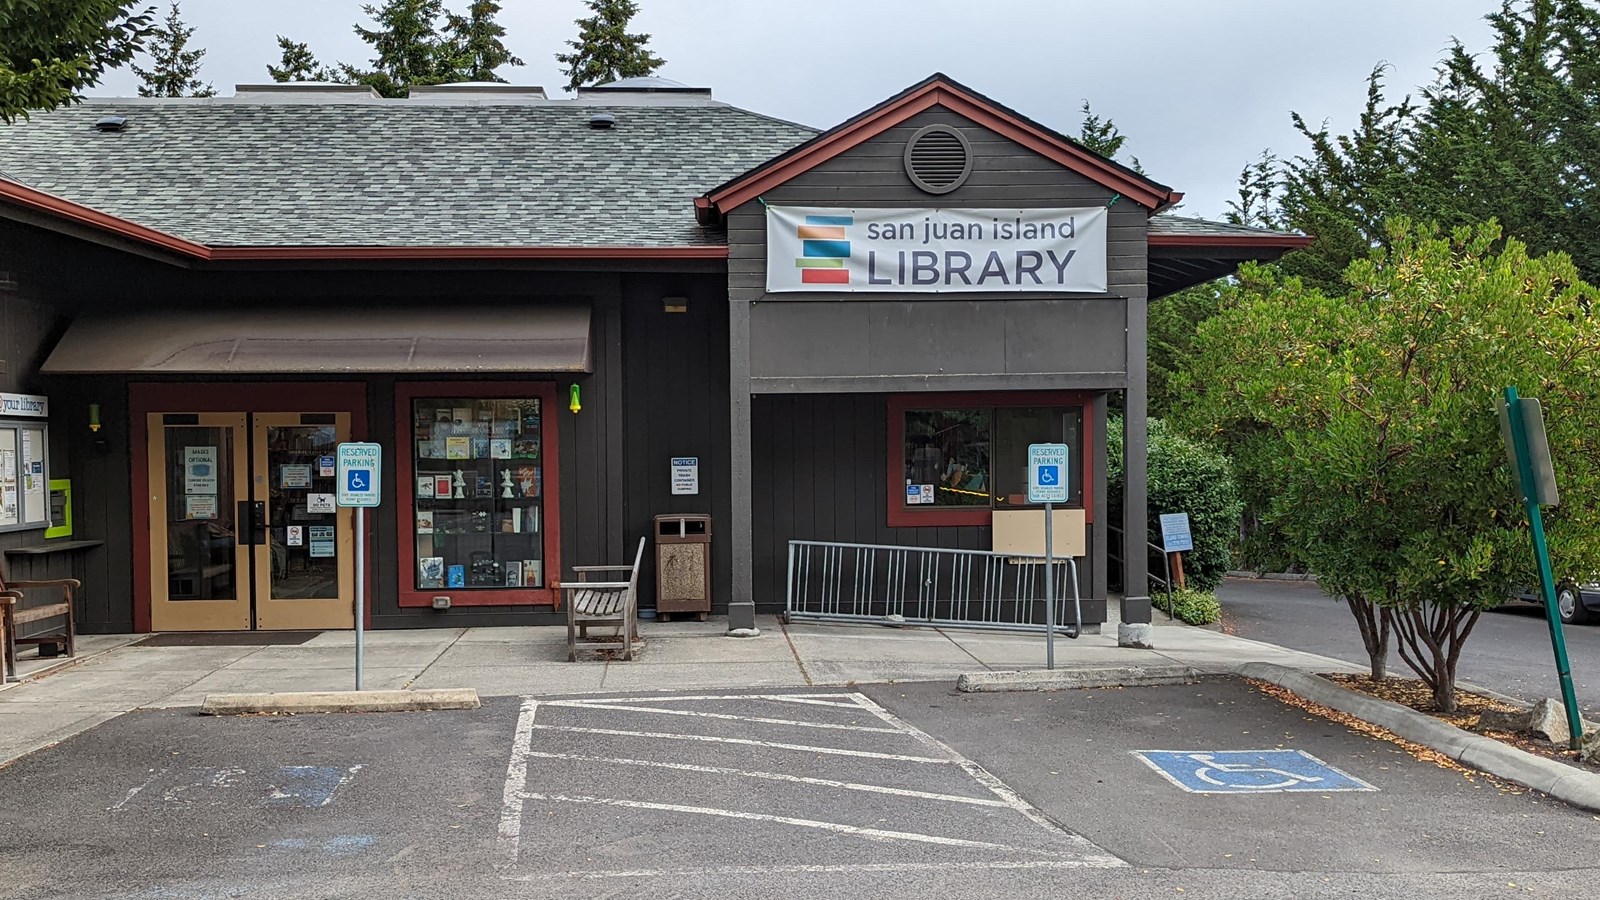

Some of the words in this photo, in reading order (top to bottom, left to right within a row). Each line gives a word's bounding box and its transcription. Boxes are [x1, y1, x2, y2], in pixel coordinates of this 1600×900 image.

[866, 222, 915, 240] san
[922, 216, 983, 245] juan
[992, 216, 1075, 240] island
[867, 249, 1077, 286] LIBRARY
[3, 399, 20, 413] your
[20, 397, 45, 415] library
[341, 448, 377, 457] RESERVED
[343, 458, 375, 468] PARKING
[1033, 457, 1064, 465] PARKING
